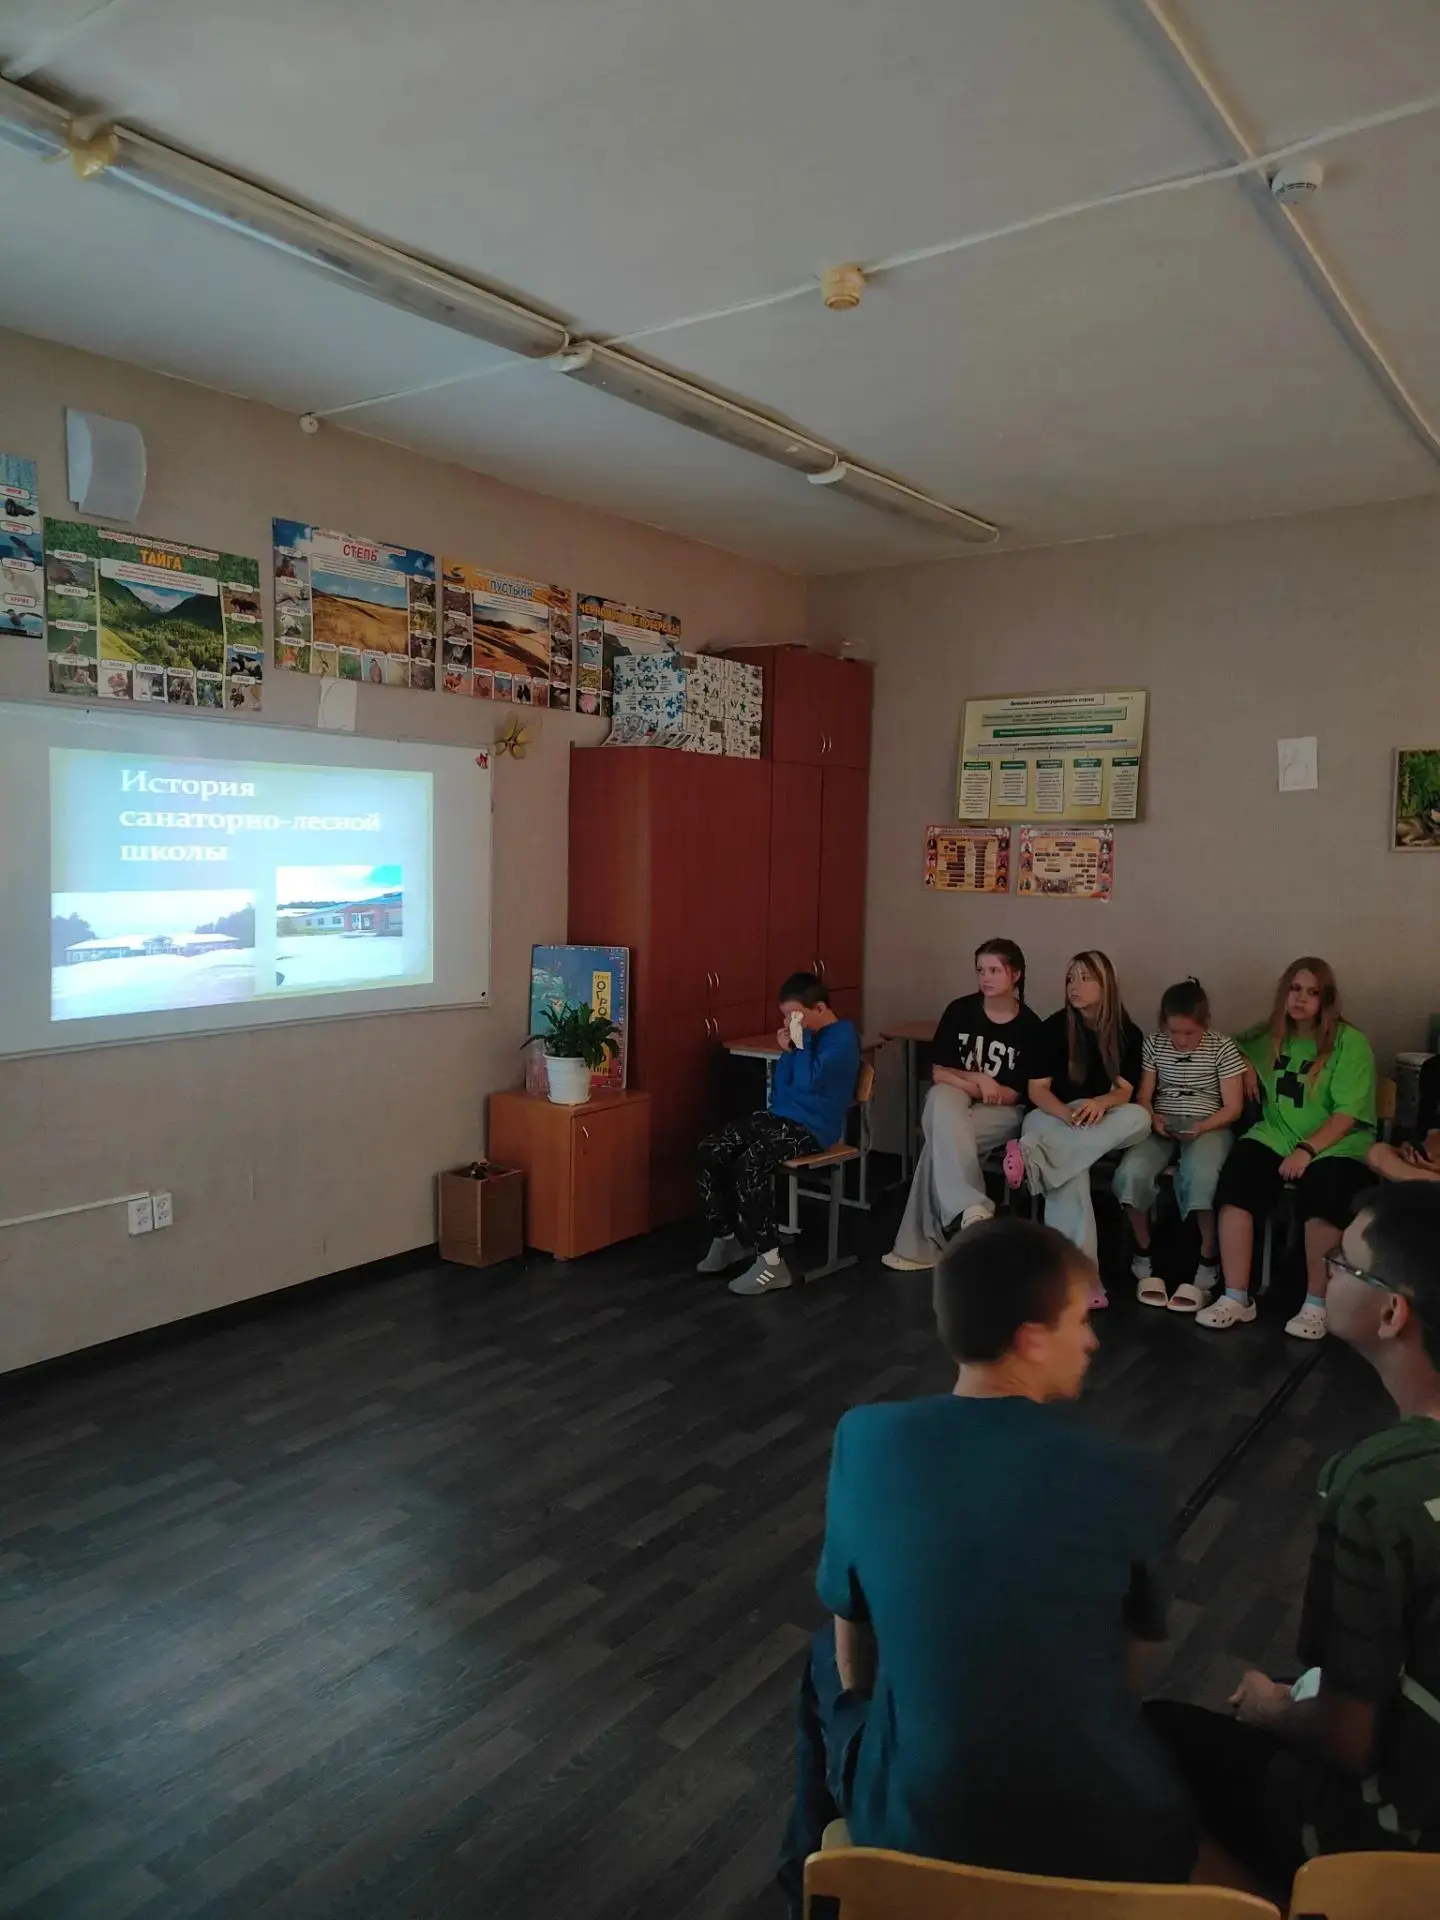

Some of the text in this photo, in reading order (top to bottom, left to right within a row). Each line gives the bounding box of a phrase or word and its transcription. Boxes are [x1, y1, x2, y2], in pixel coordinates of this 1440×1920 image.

[140, 549, 182, 570] ТАЙГА
[343, 544, 377, 562] СТЕПЬ
[490, 580, 533, 598] ПУСТЫНЯ
[640, 616, 681, 635] ПОБЕРЕЖЬЕ
[120, 769, 255, 801] История
[119, 810, 381, 835] санаторно-лесной
[120, 844, 228, 861] школы
